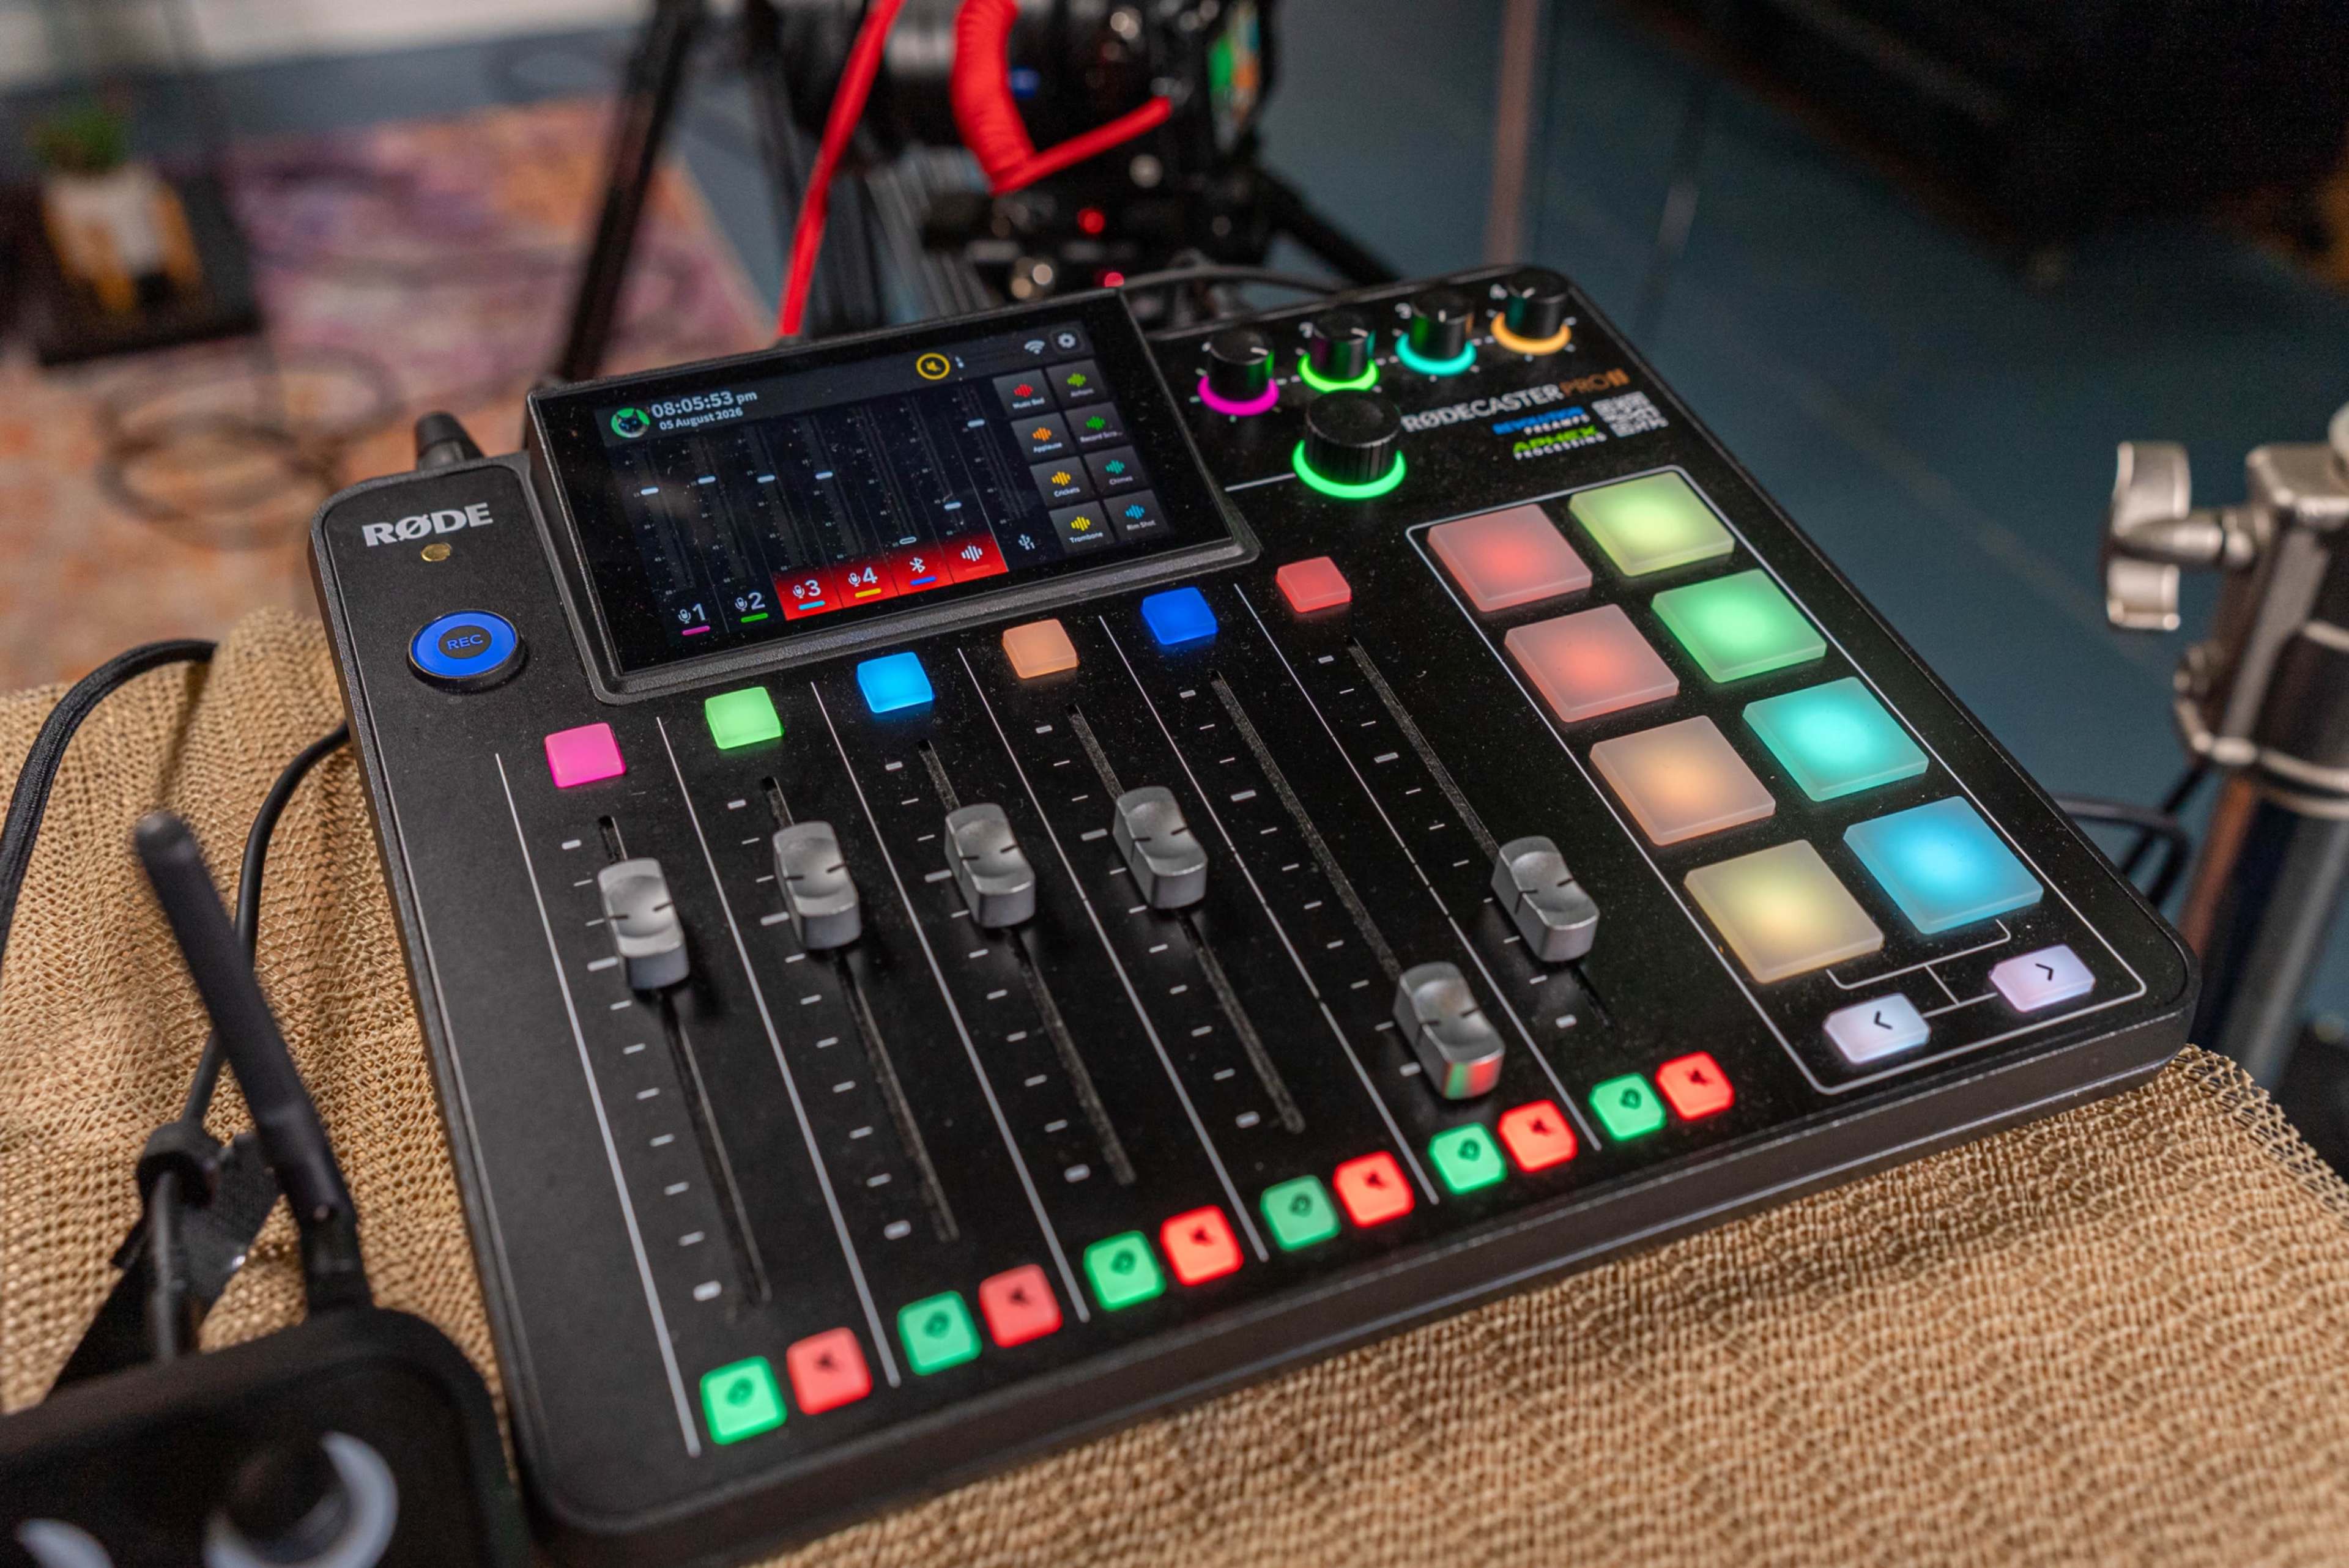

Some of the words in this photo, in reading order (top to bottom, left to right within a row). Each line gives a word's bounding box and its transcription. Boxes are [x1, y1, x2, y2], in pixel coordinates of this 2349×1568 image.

[651, 391, 733, 418] 08:05:53
[735, 391, 757, 405] pm
[1400, 383, 1565, 432] RØDECASTER
[659, 420, 674, 431] 05
[675, 413, 714, 427] August
[714, 407, 743, 421] 2026
[1033, 442, 1063, 453] Applause
[1513, 425, 1597, 453] APHEX
[1513, 432, 1608, 460] PROCESSING
[1053, 487, 1081, 497] Crickets
[362, 502, 494, 547] RØDE
[1140, 520, 1156, 528] Shot
[1069, 532, 1104, 544] Trombone
[862, 566, 878, 584] 4
[804, 580, 822, 597] 3
[748, 591, 766, 610] 2
[692, 603, 707, 621] 1
[447, 634, 483, 650] REC
